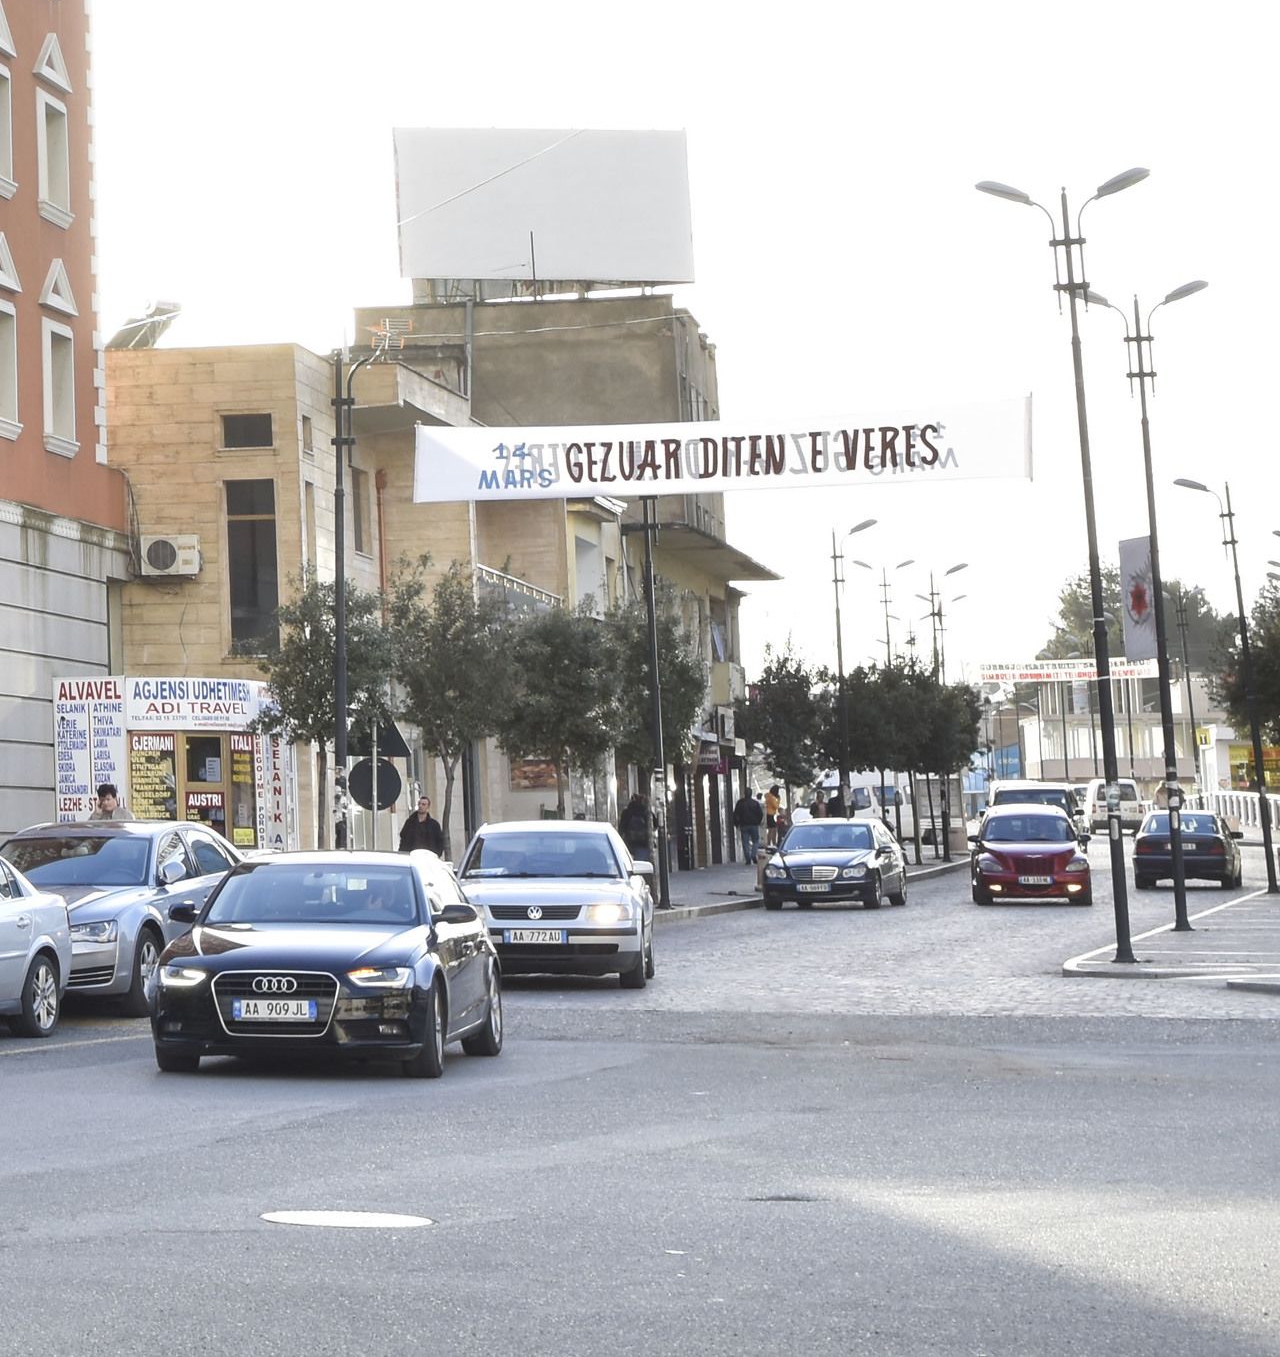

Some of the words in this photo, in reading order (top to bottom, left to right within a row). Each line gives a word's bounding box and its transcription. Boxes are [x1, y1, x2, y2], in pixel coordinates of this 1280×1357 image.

[566, 438, 681, 483] GEZUAR
[699, 435, 785, 480] DITEN
[809, 432, 822, 472] E
[842, 424, 939, 471] VERES
[478, 469, 553, 490] MARS
[59, 681, 121, 700] ALVAVEL
[133, 681, 189, 700] AGJENSI
[193, 682, 250, 701] UDHETIMESH
[57, 704, 86, 713] SELANIK
[94, 703, 122, 713] ATHINE
[146, 702, 181, 714] ADI
[188, 702, 246, 714] TRAVEL
[57, 719, 77, 729] VERIE
[93, 716, 114, 726] THIVA
[58, 730, 86, 739] KATERINE
[133, 736, 173, 751] GJERMANI
[231, 735, 251, 750] ITALI
[272, 738, 282, 822] SELANIK
[59, 798, 82, 811] LEZHE
[188, 794, 221, 806] AUSTRI
[513, 931, 524, 941] AA
[245, 1002, 259, 1015] AA
